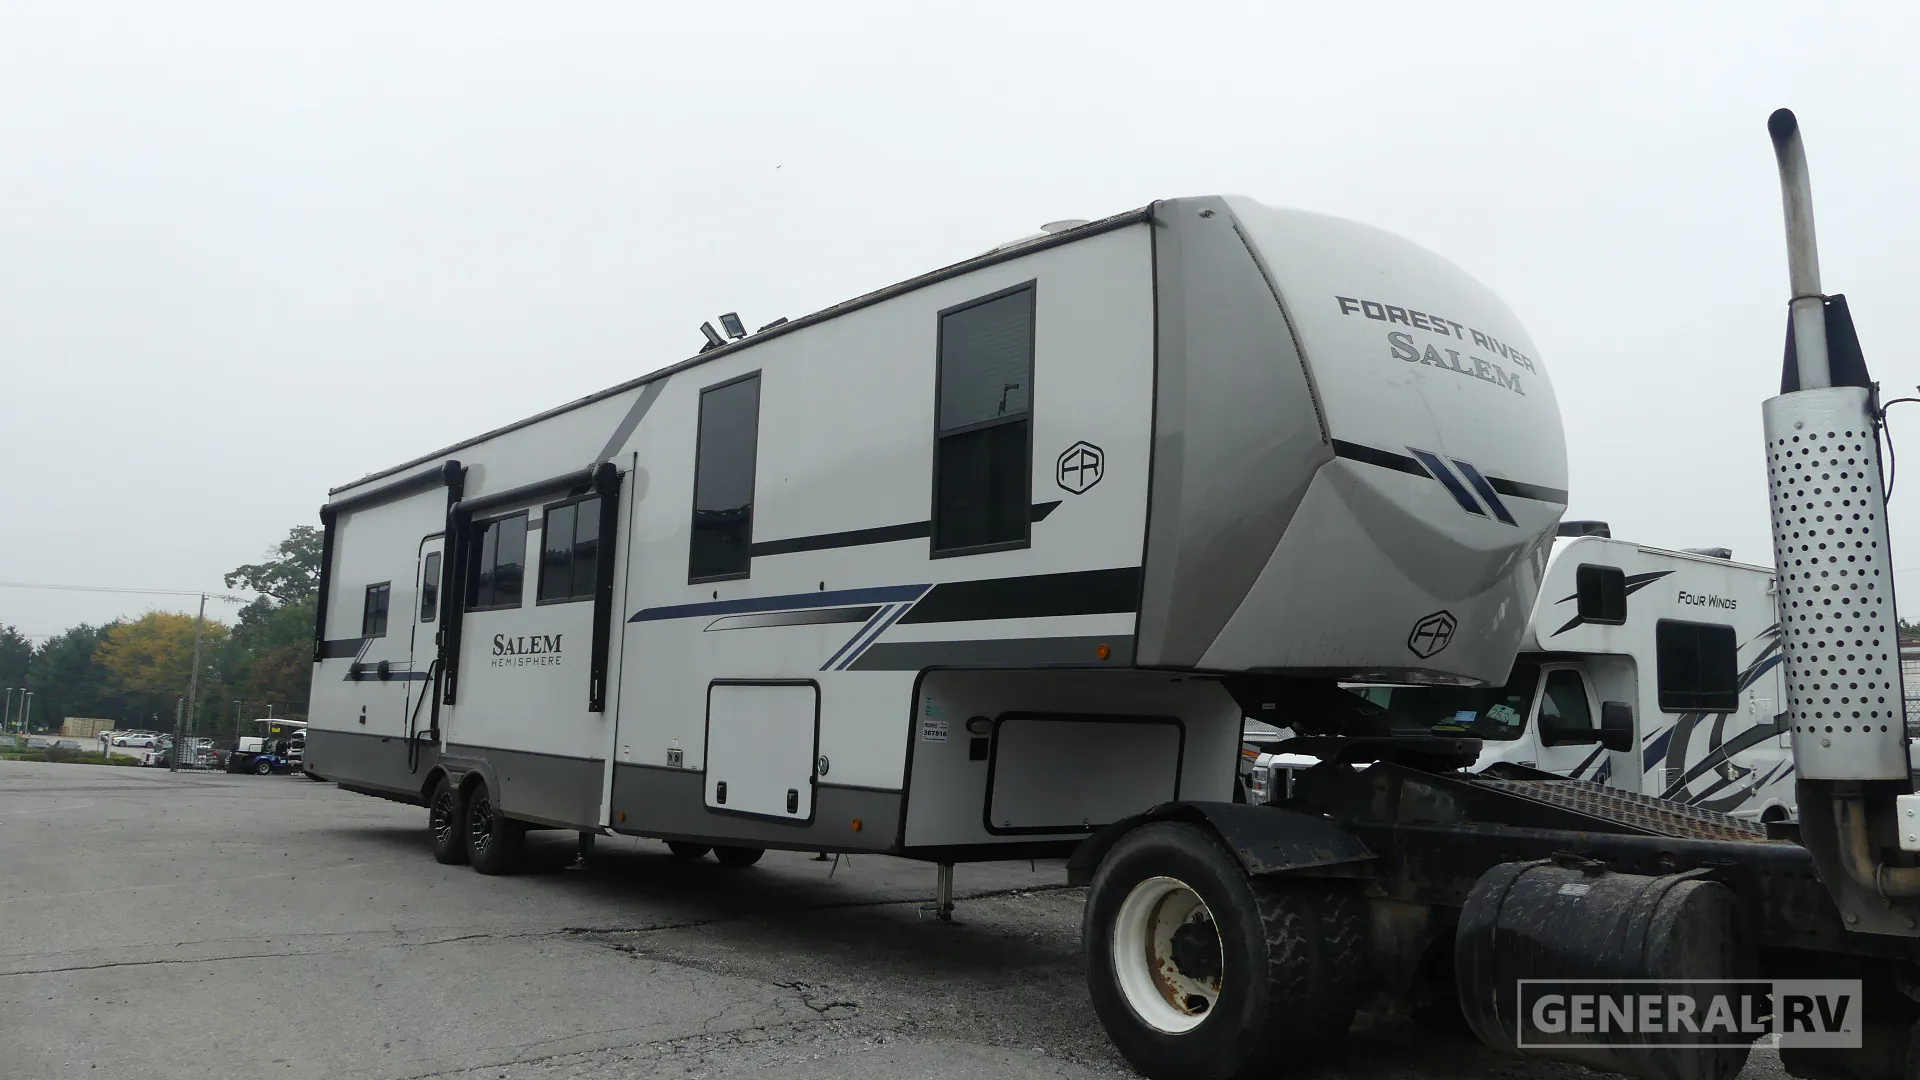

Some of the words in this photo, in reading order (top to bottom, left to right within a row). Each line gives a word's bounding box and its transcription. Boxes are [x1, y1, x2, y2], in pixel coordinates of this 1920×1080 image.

[1335, 296, 1464, 340] FOREST
[1469, 328, 1537, 375] RIVER
[1387, 332, 1526, 396] SALEM
[491, 655, 562, 668] HEMISPHERE
[492, 633, 563, 656] SALEM
